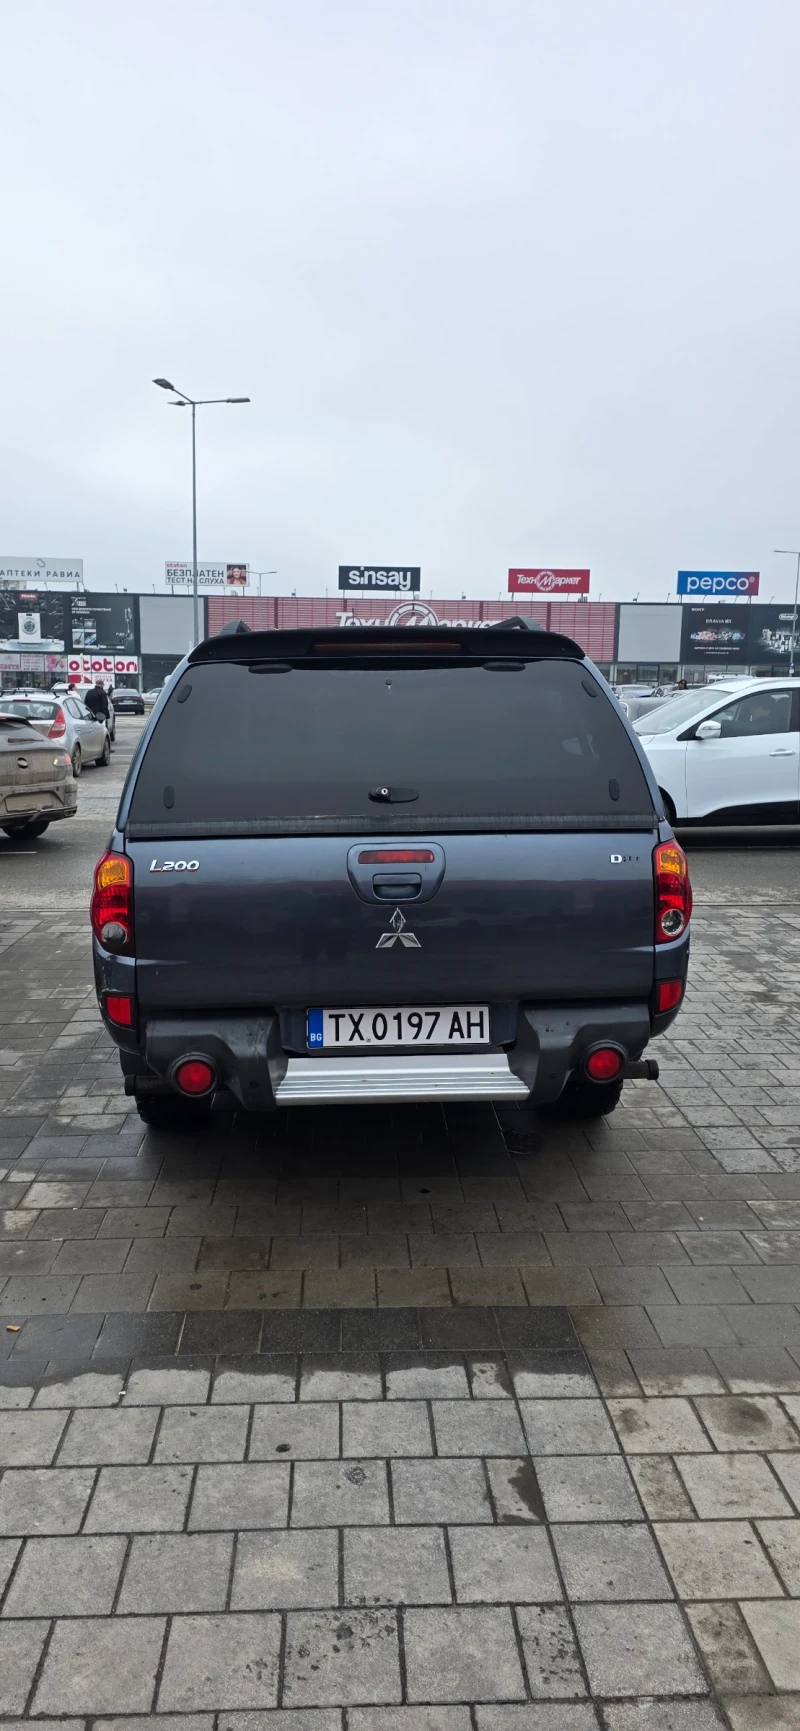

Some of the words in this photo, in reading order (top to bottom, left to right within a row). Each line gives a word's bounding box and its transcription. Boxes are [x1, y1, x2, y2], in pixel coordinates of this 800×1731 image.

[348, 566, 411, 591] sinsay
[68, 658, 138, 672] ototon
[149, 859, 200, 872] L200
[328, 1013, 365, 1042] TX
[371, 1012, 441, 1040] 0197
[448, 1011, 484, 1039] AH
[310, 1033, 322, 1042] BG
